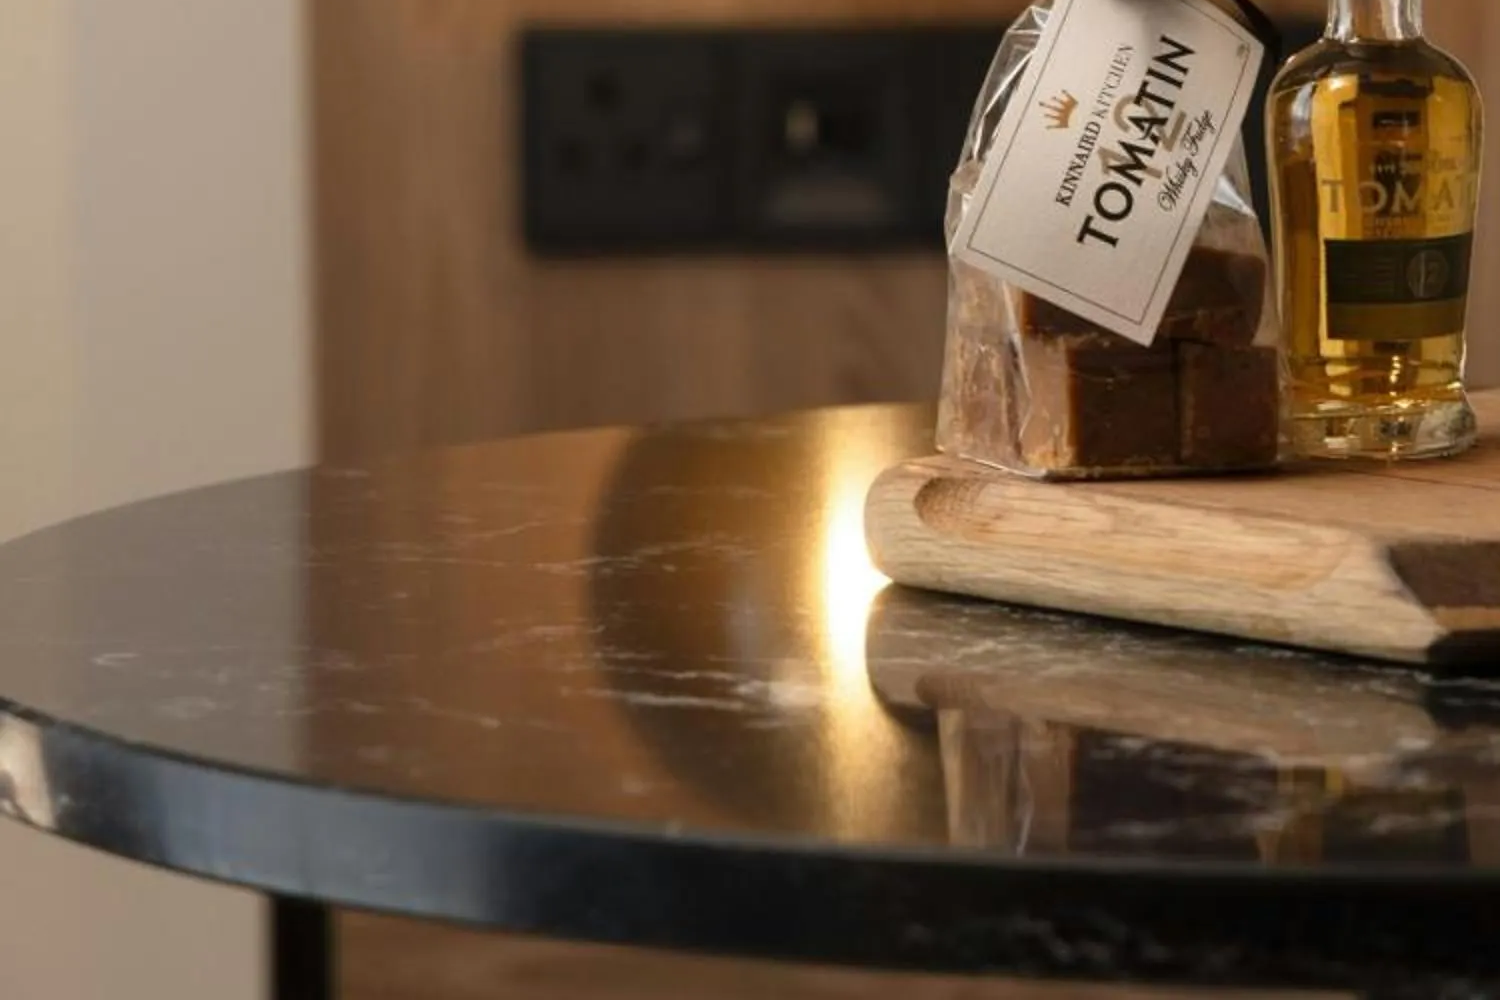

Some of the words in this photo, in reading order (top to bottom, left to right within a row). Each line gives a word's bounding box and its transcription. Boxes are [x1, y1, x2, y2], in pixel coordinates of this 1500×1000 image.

[1055, 120, 1102, 207] KINNAIRD
[1091, 44, 1135, 120] KITCHEN
[1076, 34, 1197, 249] TOMATIN
[1157, 157, 1199, 212] Whisky
[1180, 109, 1217, 157] Fudge
